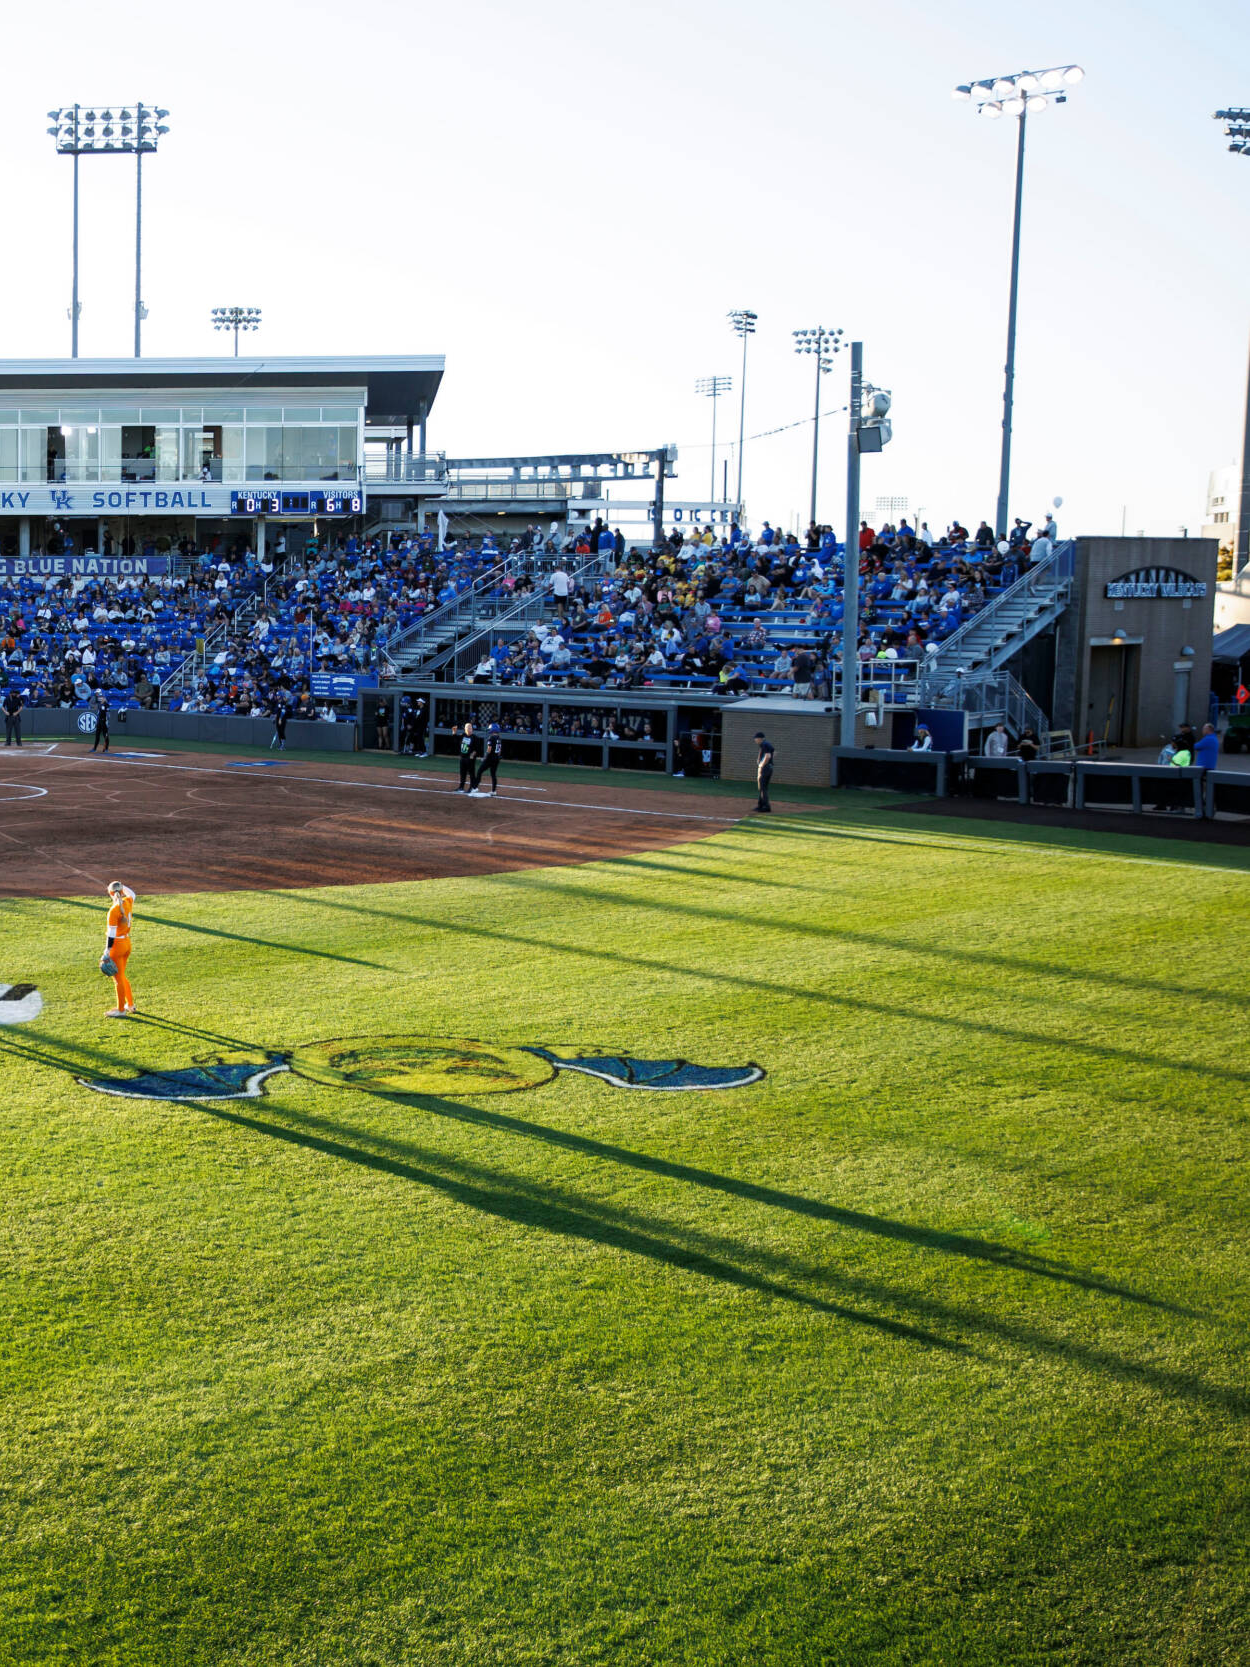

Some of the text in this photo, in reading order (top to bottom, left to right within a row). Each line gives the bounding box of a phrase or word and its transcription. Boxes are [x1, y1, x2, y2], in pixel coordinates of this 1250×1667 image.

[93, 491, 212, 508] SOFTBALL
[237, 491, 278, 500] KENTUCKY
[323, 491, 358, 499] VISITORS
[271, 499, 279, 512] 3
[326, 499, 334, 512] 6
[352, 499, 360, 512] 8
[14, 558, 65, 574] BLUE
[72, 558, 148, 574] NATION
[79, 713, 97, 732] SEC
